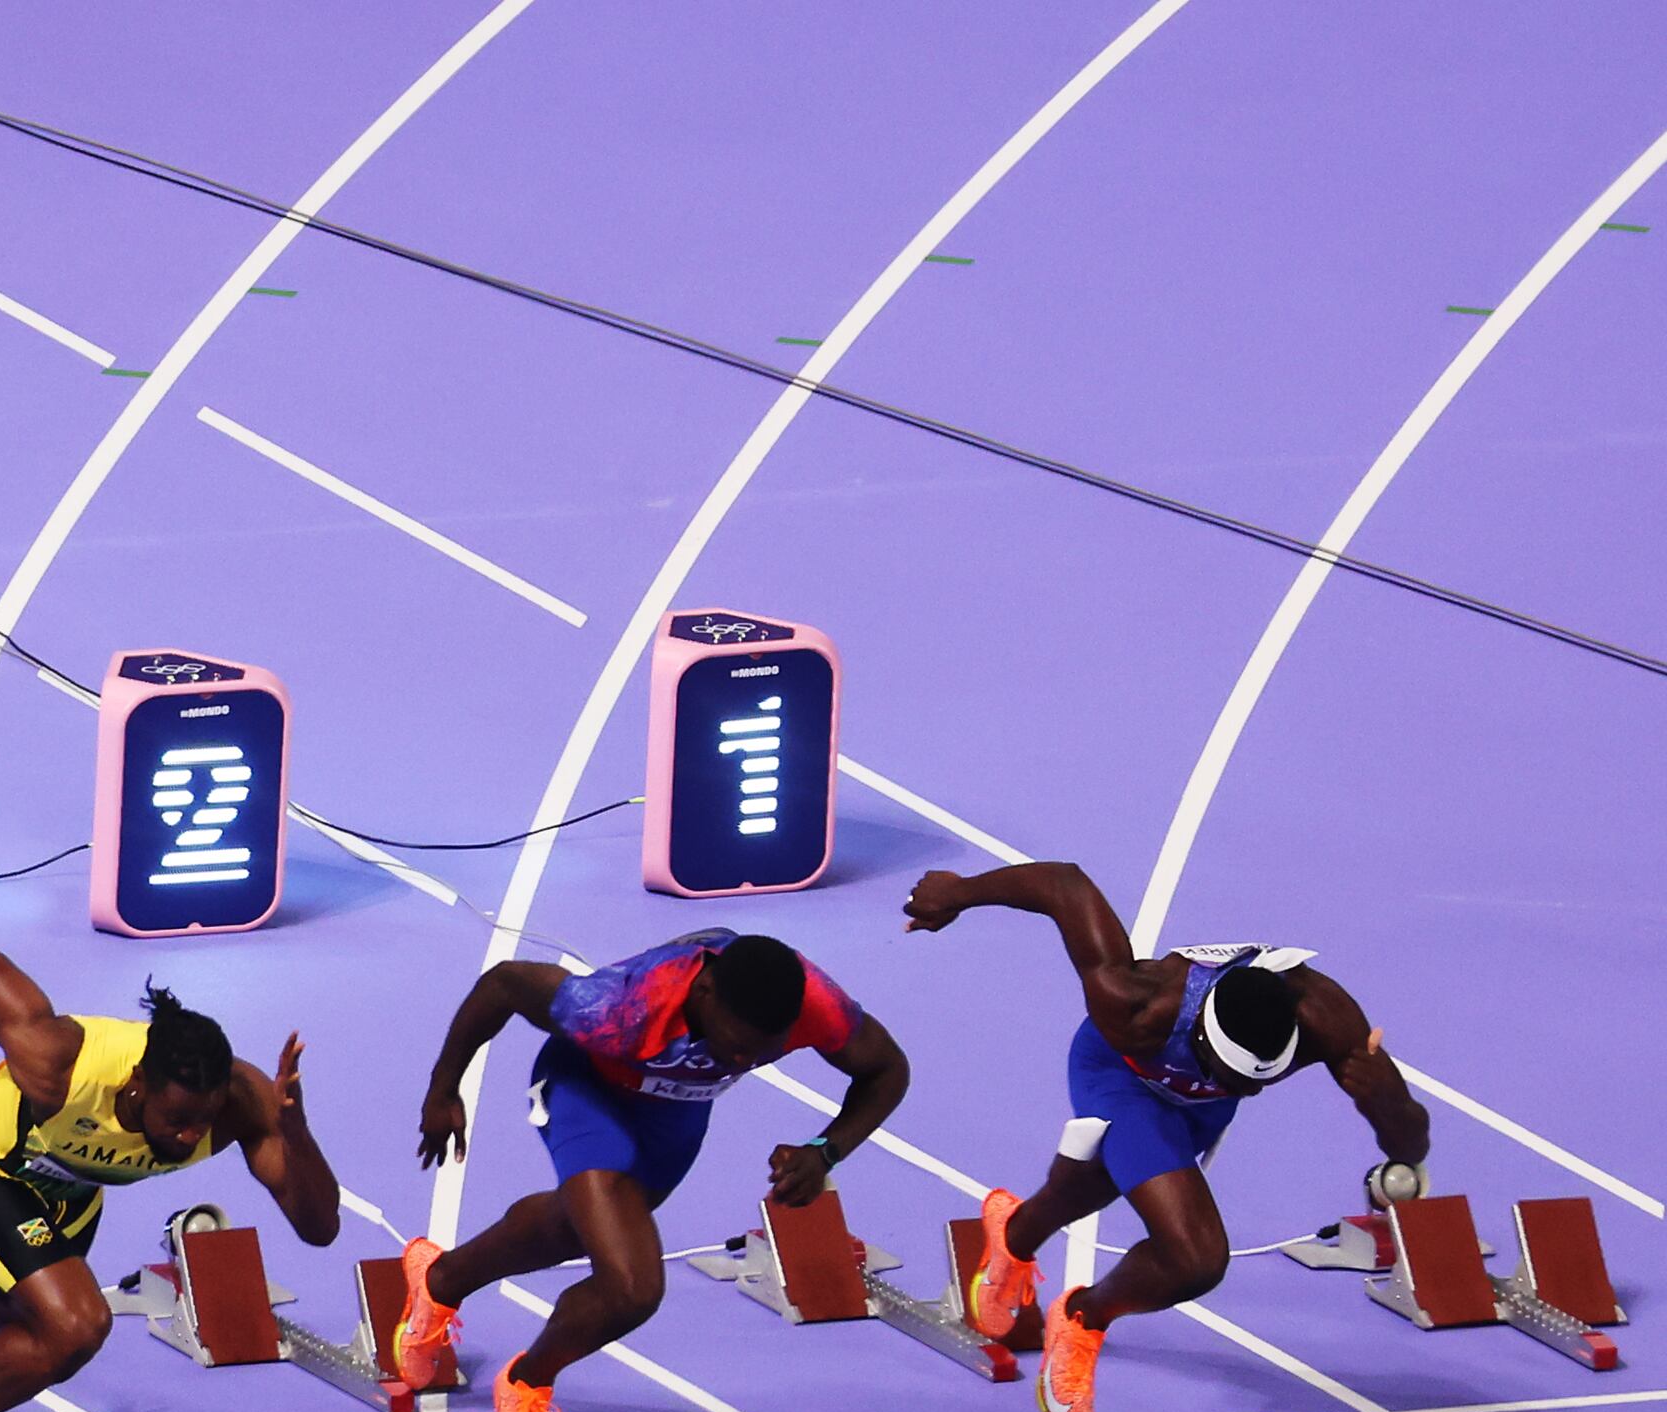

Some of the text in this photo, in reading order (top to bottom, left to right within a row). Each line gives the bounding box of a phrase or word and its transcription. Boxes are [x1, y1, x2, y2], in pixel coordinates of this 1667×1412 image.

[739, 665, 780, 677] MONDO
[188, 705, 230, 717] MONDO
[718, 696, 782, 834] 1
[149, 746, 252, 885] 2
